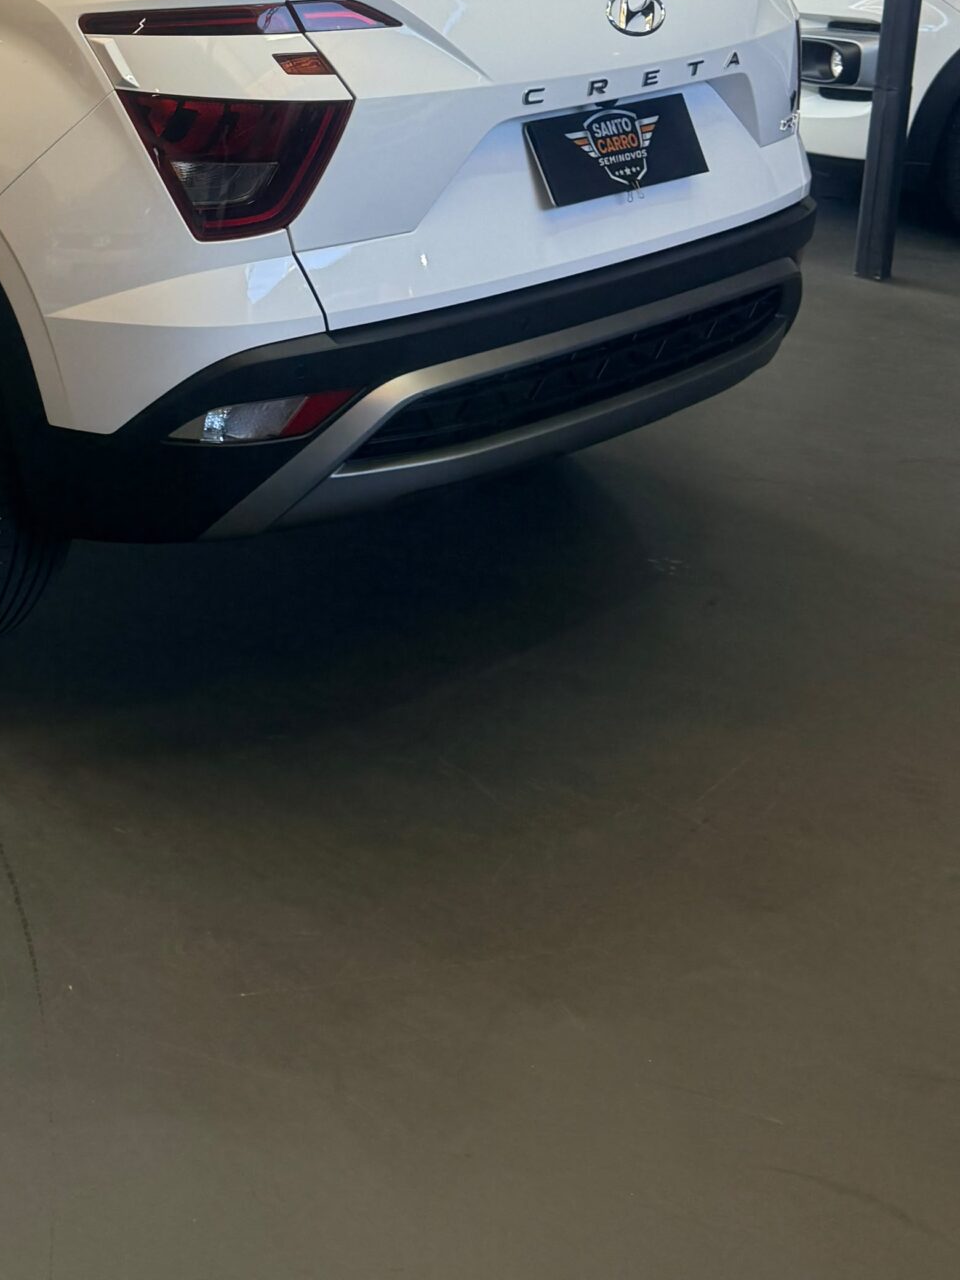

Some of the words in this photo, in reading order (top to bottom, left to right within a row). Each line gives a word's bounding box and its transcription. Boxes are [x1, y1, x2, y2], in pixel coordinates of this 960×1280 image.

[522, 51, 741, 106] CRETA
[592, 117, 633, 138] SANTO
[597, 132, 639, 154] CARRO
[598, 148, 648, 167] SEMINOVOS
